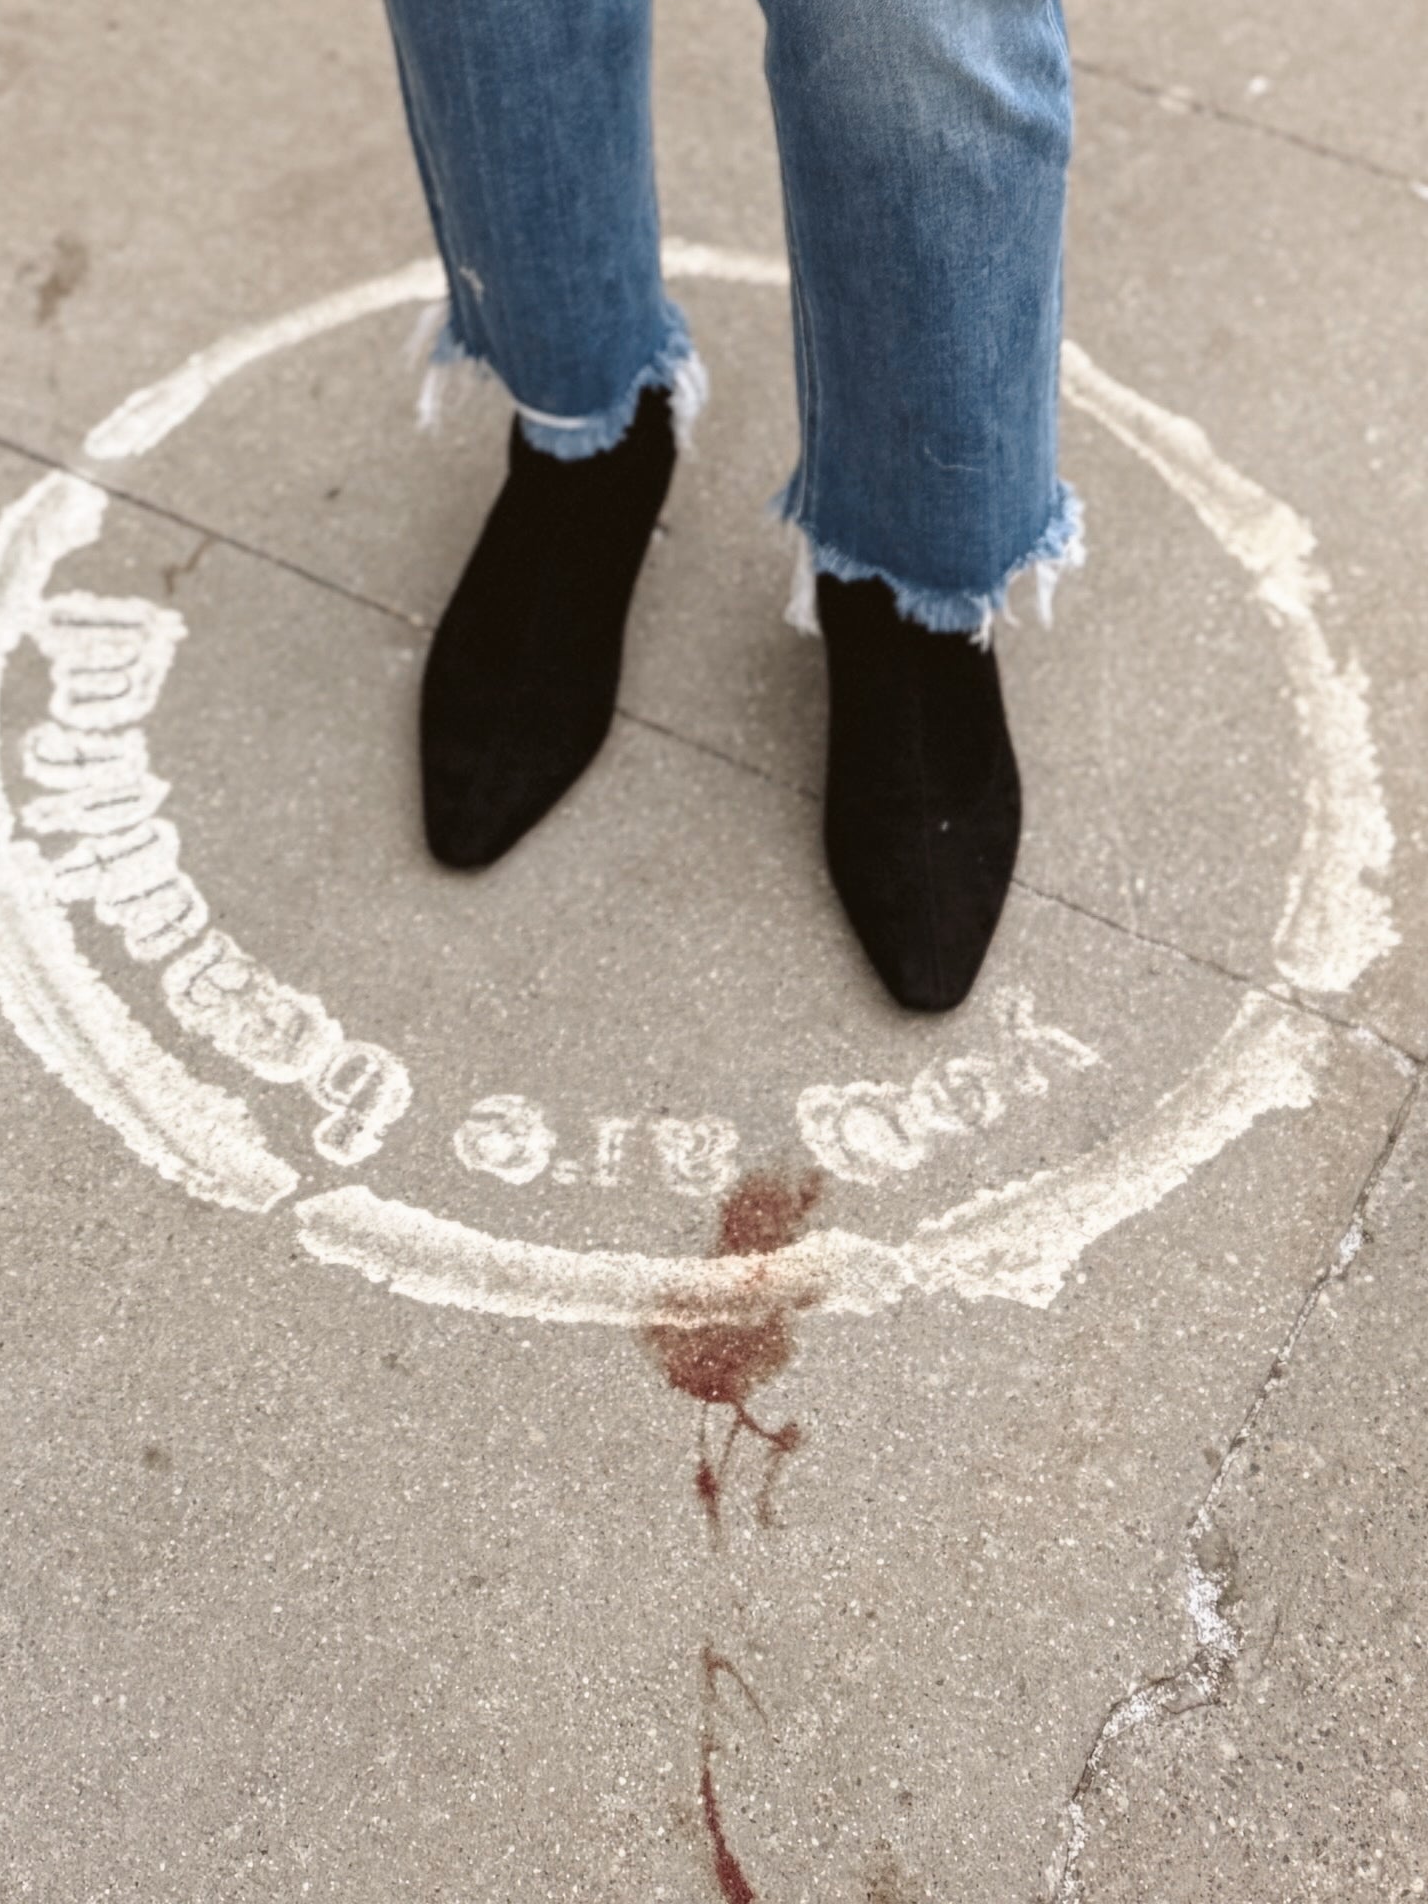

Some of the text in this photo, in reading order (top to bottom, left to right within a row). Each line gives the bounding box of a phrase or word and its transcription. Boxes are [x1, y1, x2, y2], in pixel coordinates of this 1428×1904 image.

[22, 590, 1102, 1195] you are beautiful
